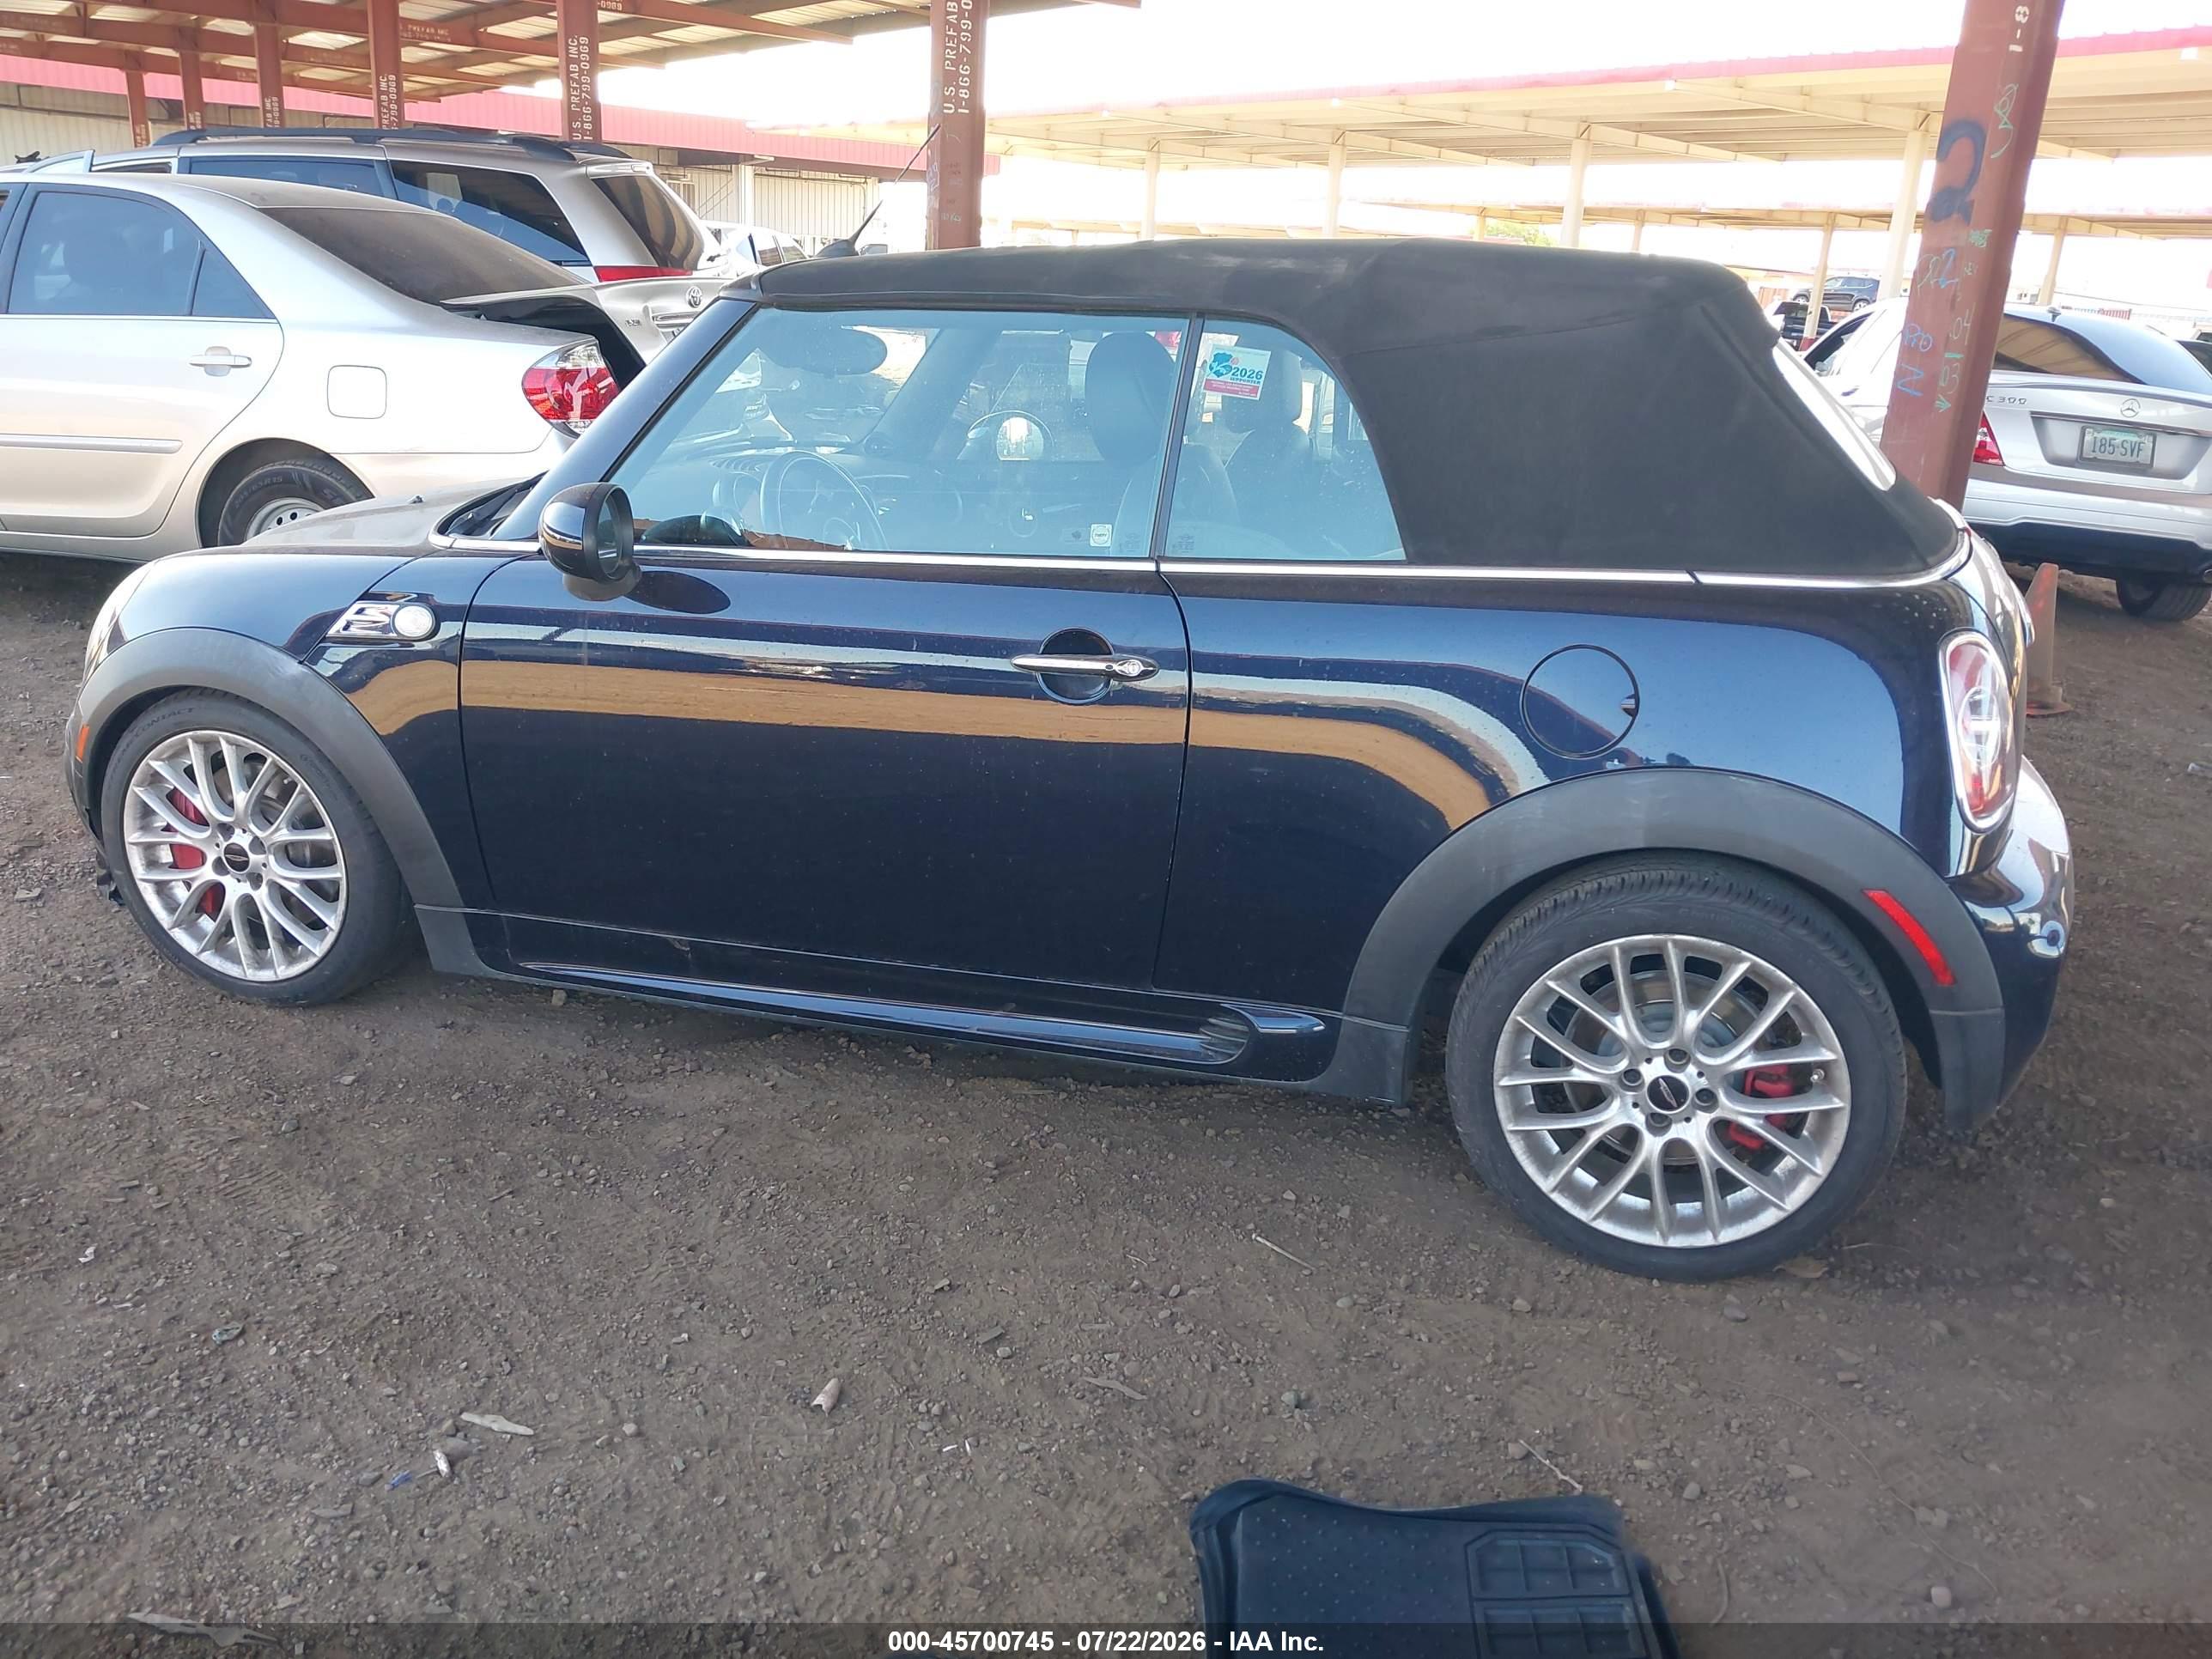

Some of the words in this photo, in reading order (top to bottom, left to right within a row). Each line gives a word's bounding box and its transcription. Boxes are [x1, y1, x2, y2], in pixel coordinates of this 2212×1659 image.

[568, 35, 579, 58] INC.
[945, 1, 958, 70] PREFAB
[569, 64, 580, 111] PREFAB
[943, 82, 956, 113] U.S.
[572, 118, 582, 140] U.S.
[1231, 367, 1264, 380] 2026
[1998, 396, 2027, 404] 300
[2119, 439, 2146, 459] SVF
